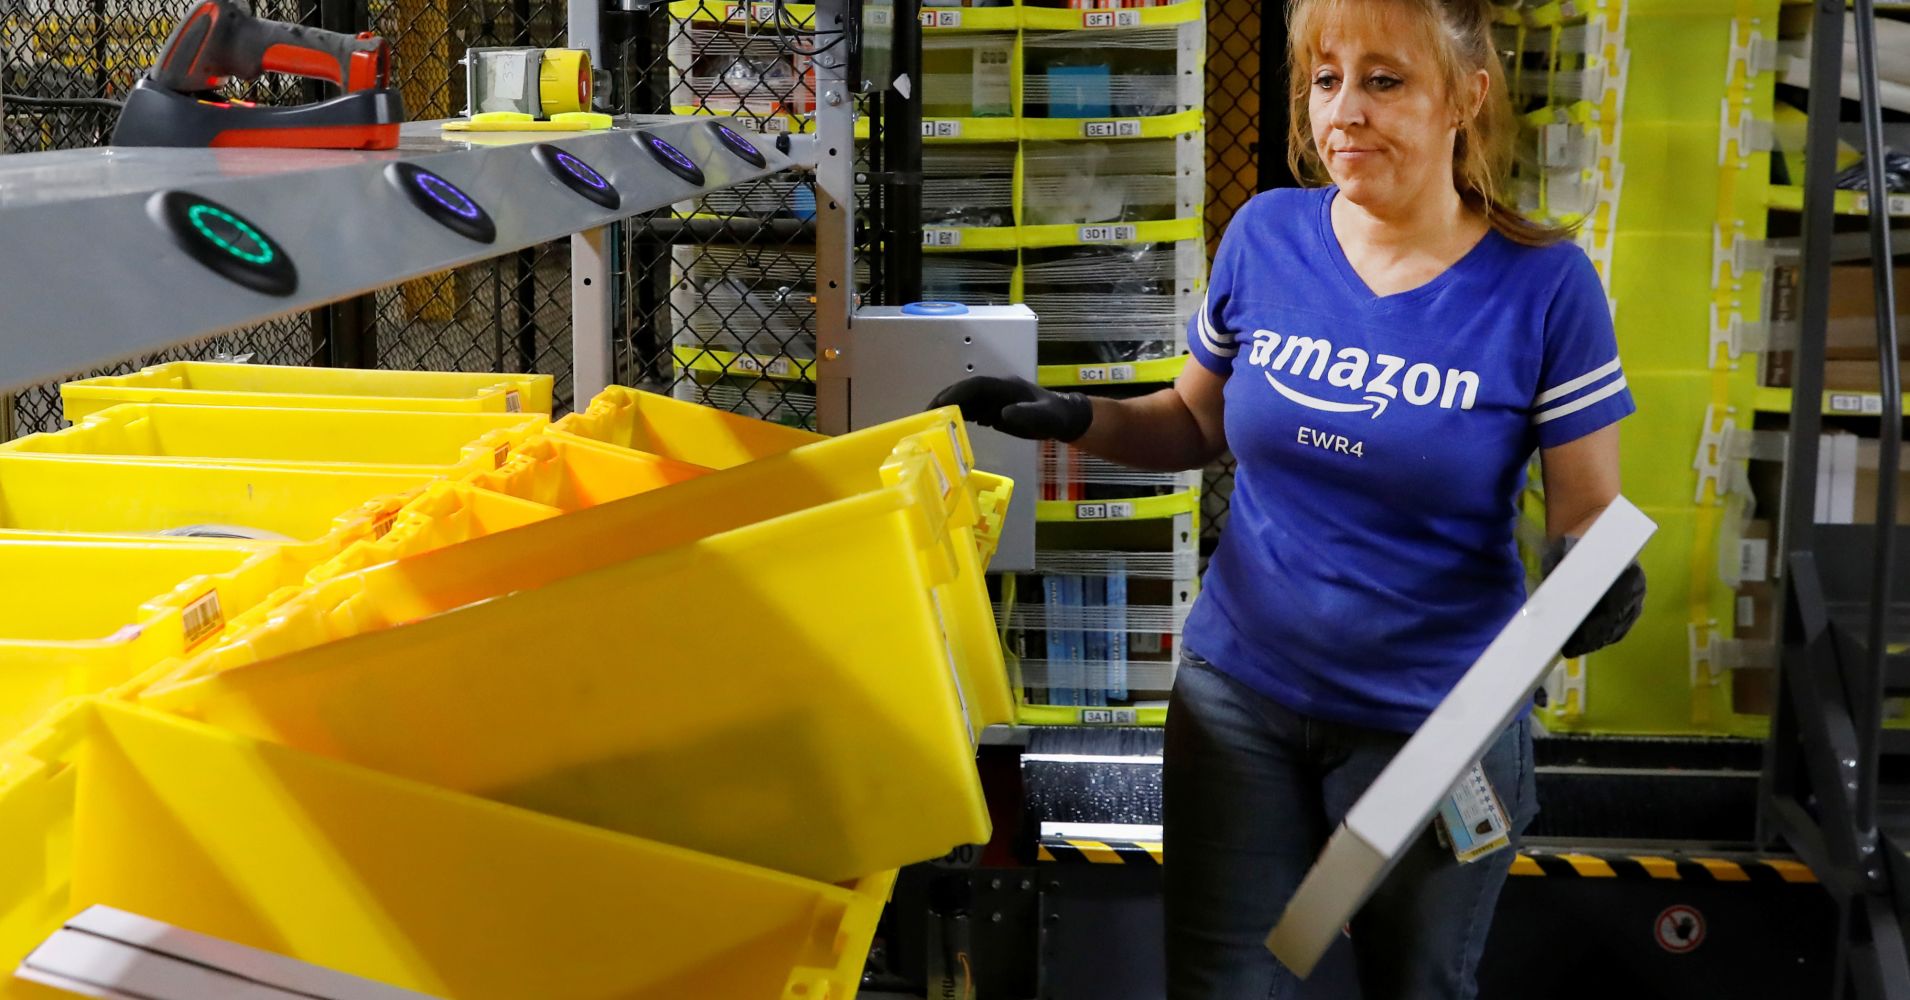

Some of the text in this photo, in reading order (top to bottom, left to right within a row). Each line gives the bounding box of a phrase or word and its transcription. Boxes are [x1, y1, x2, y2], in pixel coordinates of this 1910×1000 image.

[1089, 15, 1102, 25] 3F
[1089, 125, 1104, 135] 3E
[1085, 229, 1099, 239] 3D
[1249, 329, 1479, 410] amazon
[1081, 370, 1096, 380] 3C
[1296, 426, 1364, 458] EWR4
[1081, 507, 1095, 517] 3B
[1087, 712, 1101, 721] 3A
